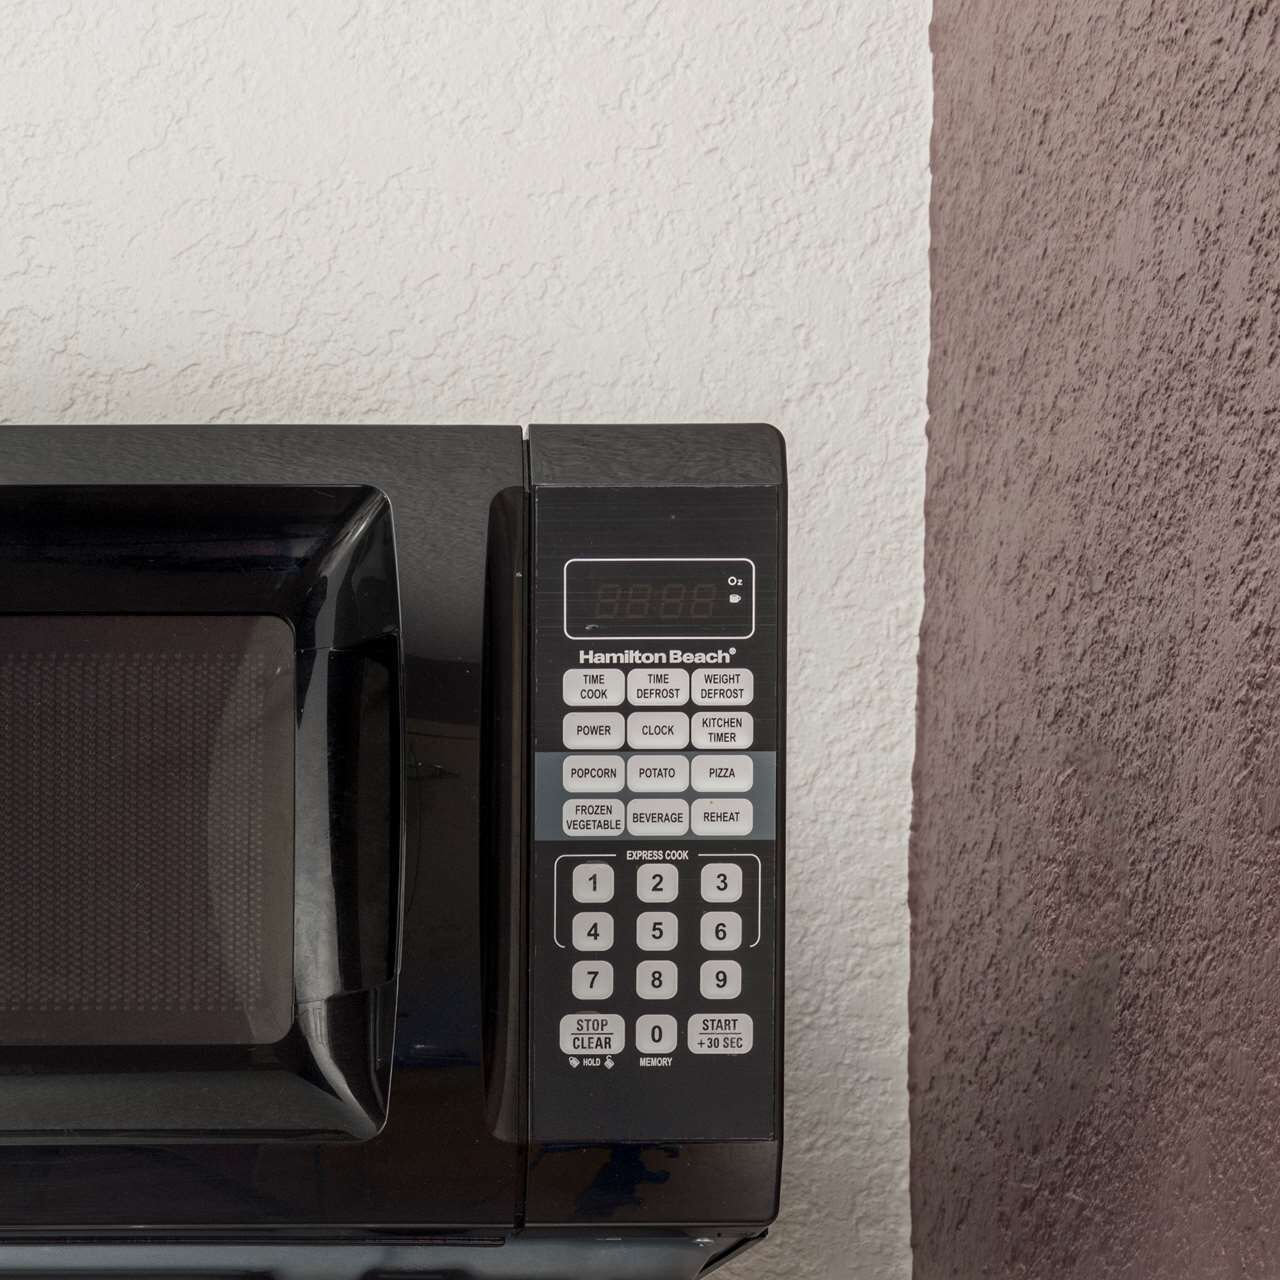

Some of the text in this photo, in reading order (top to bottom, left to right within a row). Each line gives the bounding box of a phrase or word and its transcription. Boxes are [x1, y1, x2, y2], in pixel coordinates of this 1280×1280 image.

[579, 650, 666, 664] Hamilton
[583, 674, 605, 685] TIME
[648, 674, 669, 684] TIME
[704, 674, 740, 684] WEIGHT
[580, 688, 608, 699] COOK
[636, 688, 680, 699] DEFROST
[700, 688, 744, 699] DEFROST
[702, 717, 742, 728] KITCHEN
[576, 725, 611, 736] POWER
[641, 725, 674, 736] CLOCK
[708, 732, 736, 743] TIMER
[570, 768, 617, 779] POPCORN
[638, 768, 676, 779] POTATO
[709, 768, 735, 778] PIZZA
[575, 805, 613, 815] FROZEN
[632, 812, 684, 823] BEVERAGE
[703, 812, 740, 822] REHEAT
[566, 819, 621, 830] VEGETABLE
[626, 850, 689, 861] EXPRESS COOK
[588, 873, 598, 892] 1
[651, 873, 664, 892] 2
[716, 873, 728, 891] 3
[586, 922, 600, 941] 4
[651, 922, 664, 940] 5
[714, 922, 727, 941] 6
[587, 971, 599, 989] 7
[651, 970, 663, 989] 8
[715, 970, 727, 989] 9
[576, 1019, 608, 1032] STOP
[702, 1019, 738, 1032] START
[651, 1025, 663, 1043] 0
[572, 1036, 612, 1050] CLEAR
[723, 1036, 743, 1049] SEC
[583, 1057, 601, 1067] HOLD
[639, 1057, 672, 1067] MEMORY
